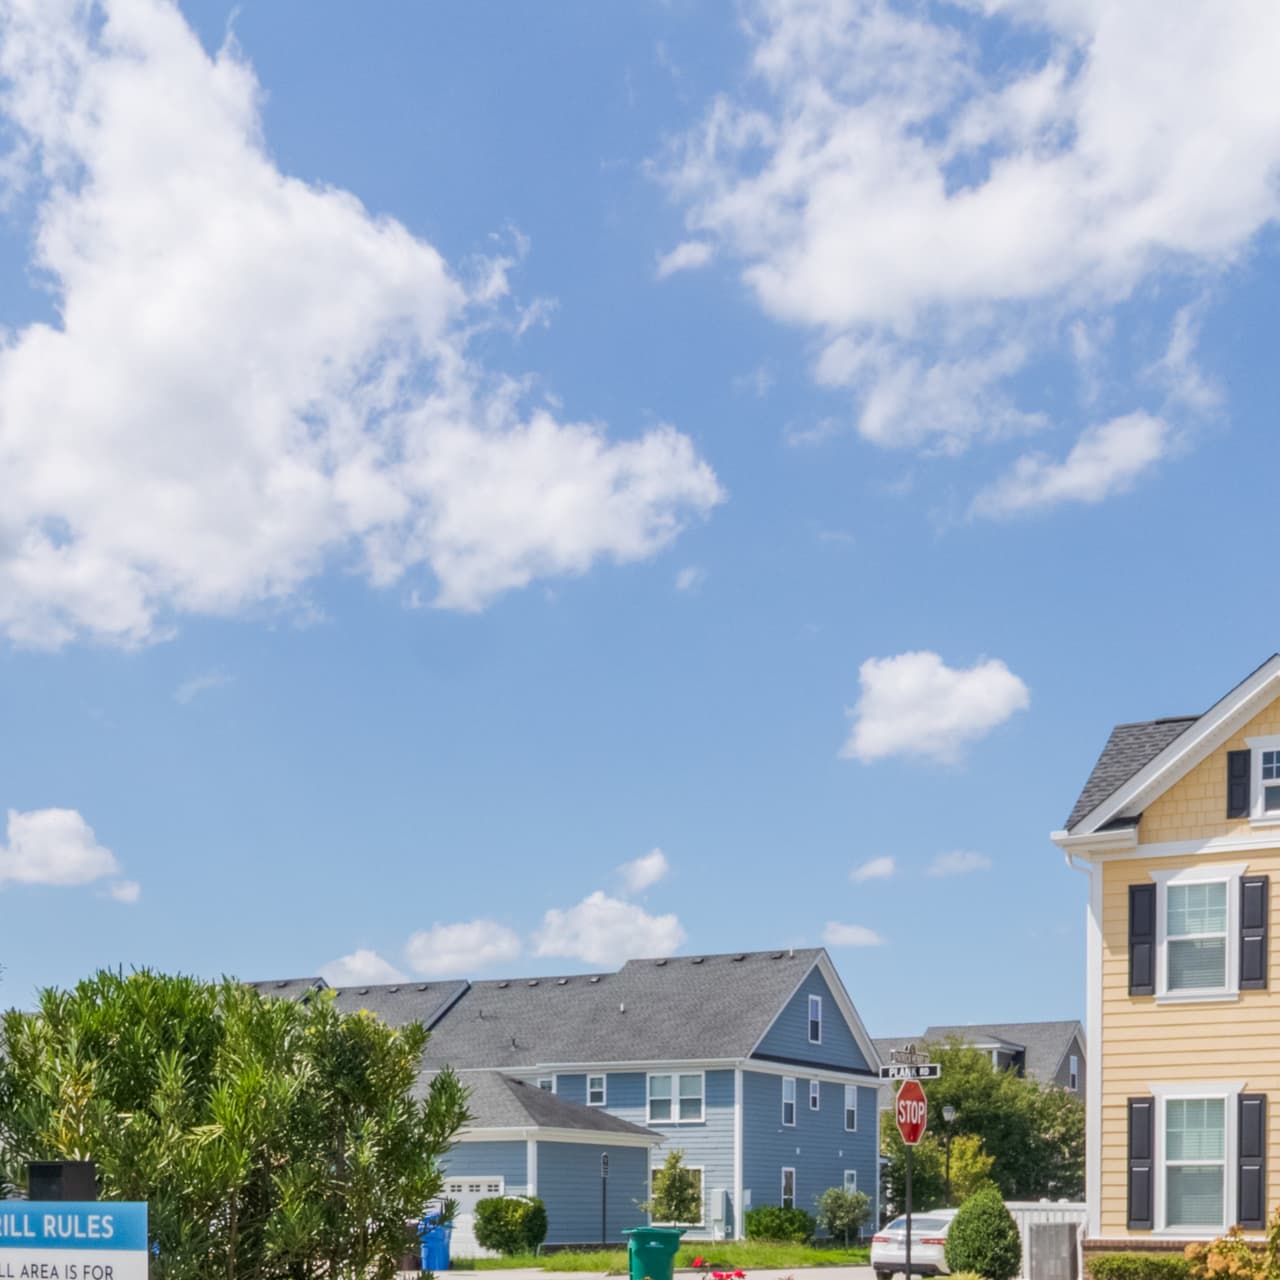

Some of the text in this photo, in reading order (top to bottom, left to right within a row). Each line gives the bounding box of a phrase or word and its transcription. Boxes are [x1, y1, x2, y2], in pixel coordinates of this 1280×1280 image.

[899, 1100, 925, 1124] STOP
[43, 1214, 114, 1239] RULES
[20, 1264, 59, 1280] AREA
[65, 1265, 78, 1280] IS
[83, 1265, 114, 1280] FOR
